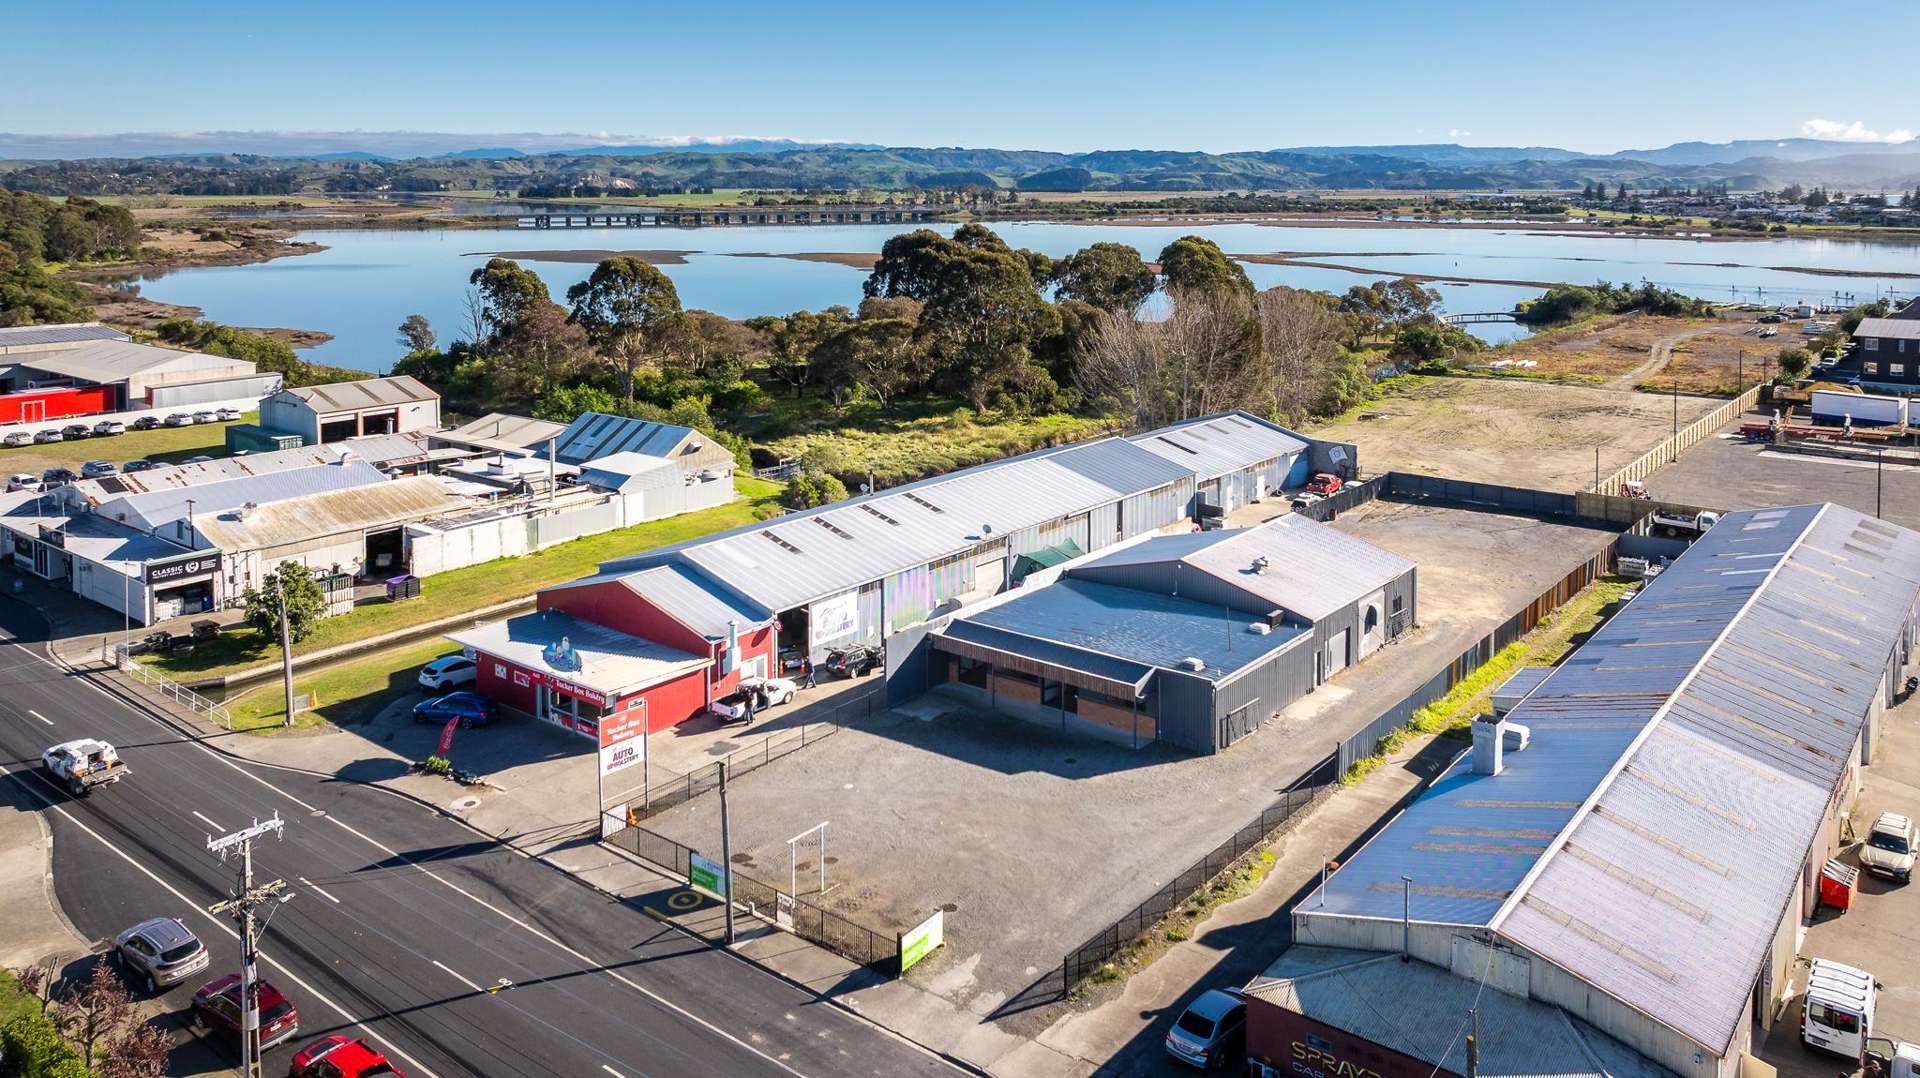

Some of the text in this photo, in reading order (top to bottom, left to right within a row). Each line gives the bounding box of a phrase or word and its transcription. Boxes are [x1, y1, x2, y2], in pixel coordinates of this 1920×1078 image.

[152, 565, 183, 577] CLASSIC
[556, 680, 573, 692] Tucker
[612, 747, 634, 762] AUTO
